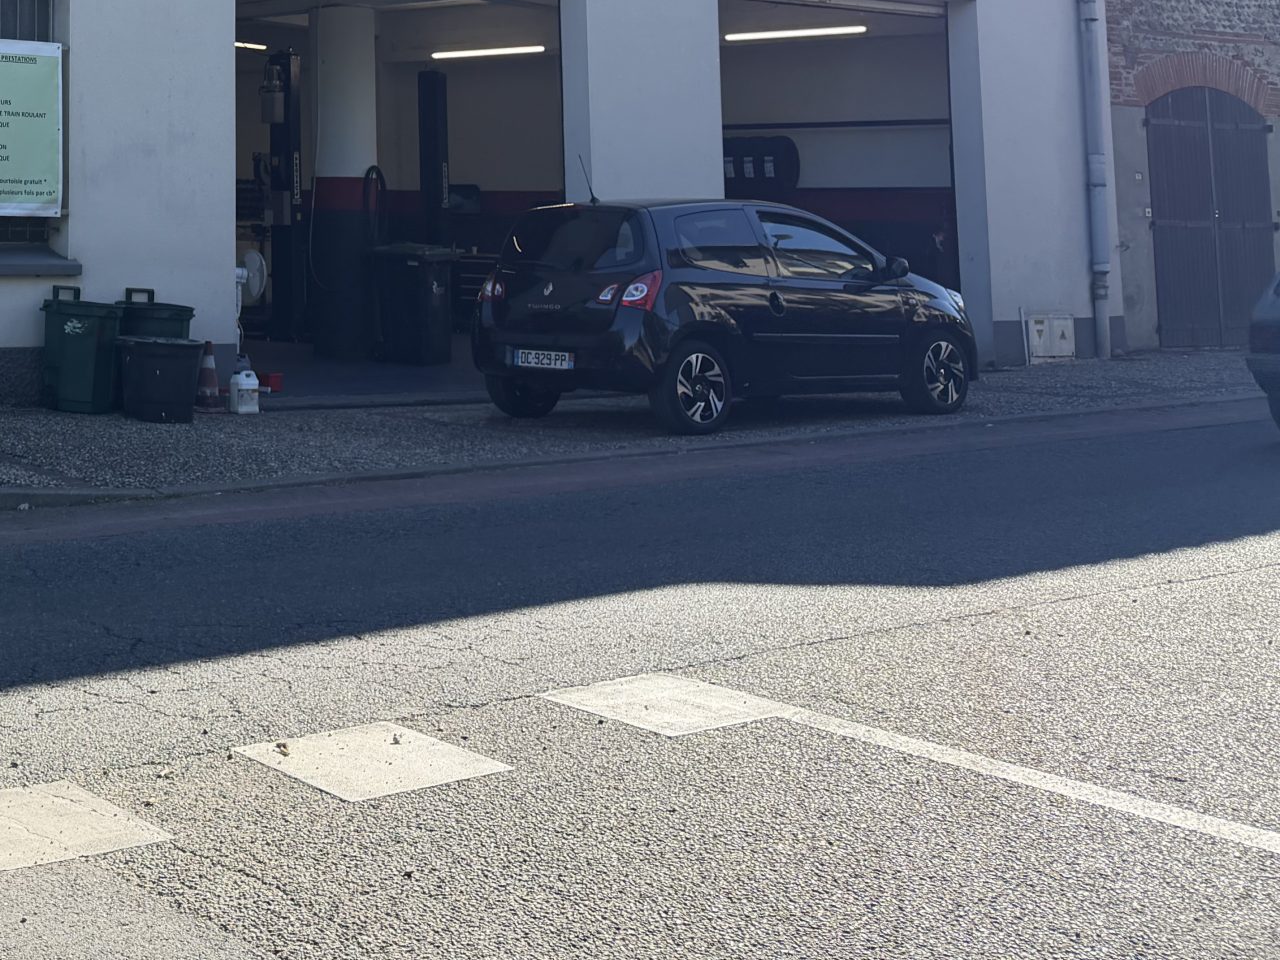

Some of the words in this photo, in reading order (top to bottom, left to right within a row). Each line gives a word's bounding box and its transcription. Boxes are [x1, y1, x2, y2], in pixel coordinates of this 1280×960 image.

[1, 55, 37, 64] PRESTATIONS
[21, 111, 47, 119] ROULANT
[23, 178, 43, 186] gratuit
[520, 351, 567, 367] DC-929-PP
